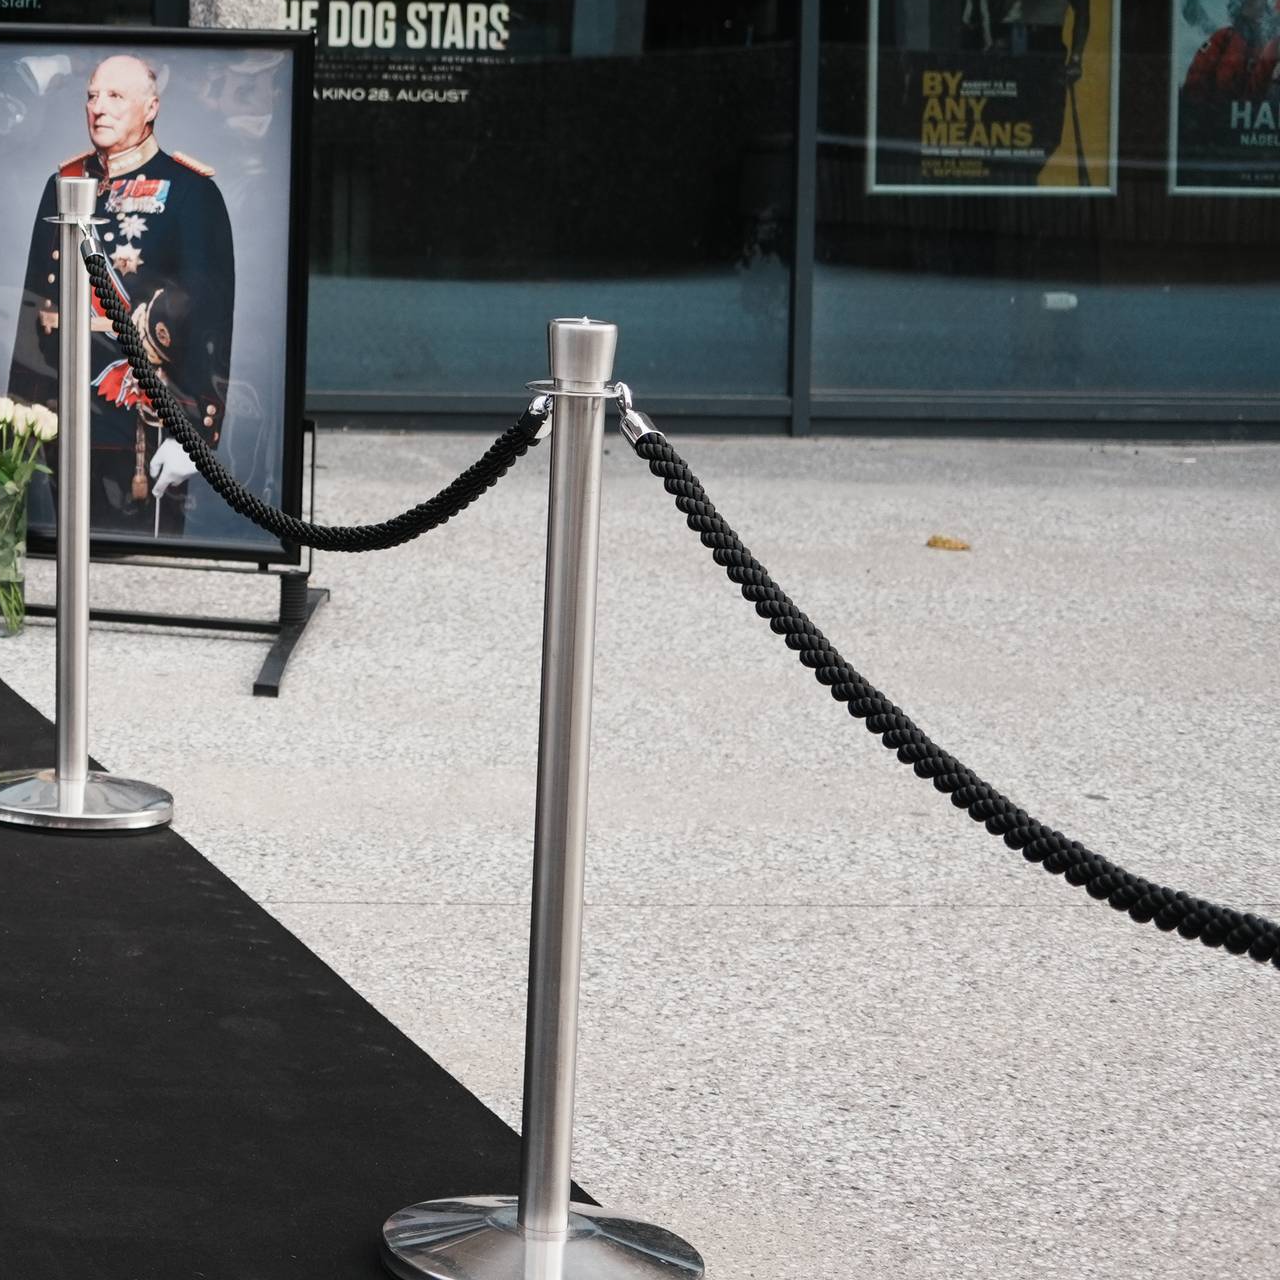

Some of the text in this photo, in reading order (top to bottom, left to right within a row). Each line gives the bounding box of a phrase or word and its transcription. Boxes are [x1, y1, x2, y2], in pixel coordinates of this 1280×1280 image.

[327, 0, 397, 48] DOG
[406, 2, 510, 50] STARS
[322, 87, 366, 102] KINO
[368, 88, 393, 102] 28.
[396, 88, 470, 103] AUGUST
[922, 71, 963, 96] BY
[922, 97, 987, 121] ANY
[1231, 101, 1280, 130] HA
[921, 123, 1033, 147] MEANS
